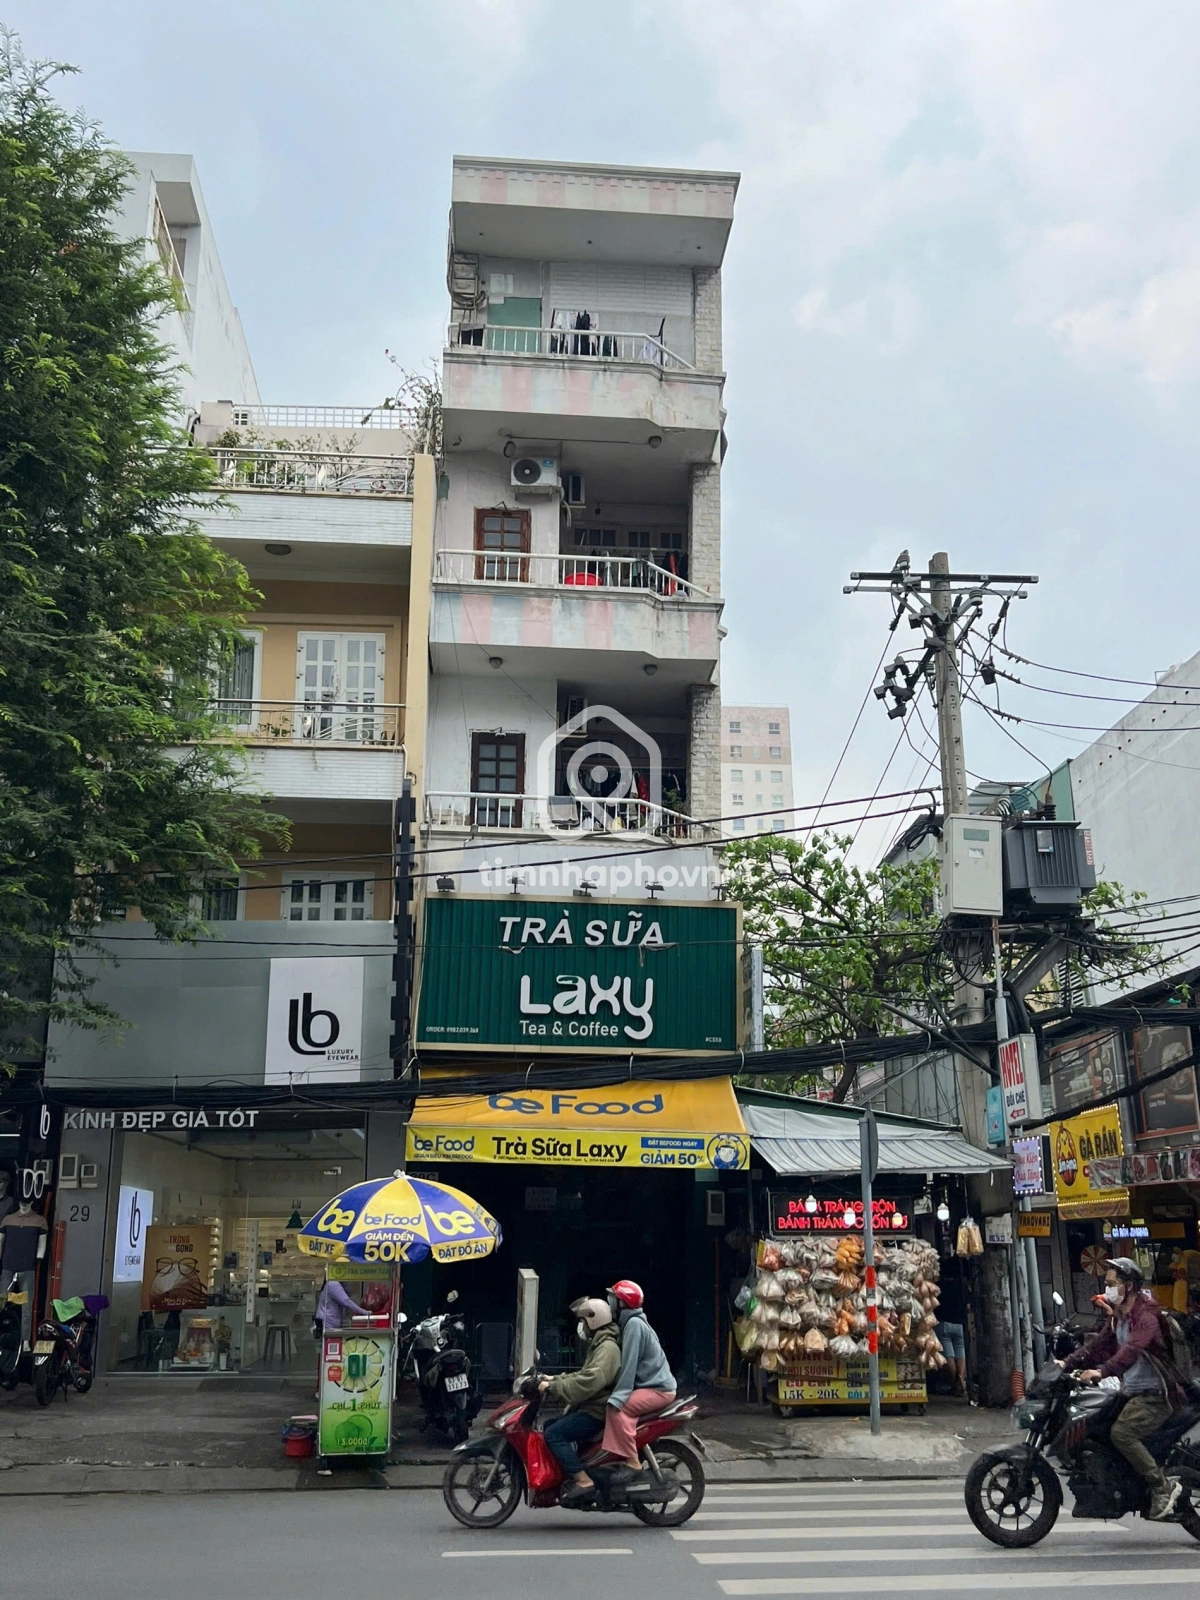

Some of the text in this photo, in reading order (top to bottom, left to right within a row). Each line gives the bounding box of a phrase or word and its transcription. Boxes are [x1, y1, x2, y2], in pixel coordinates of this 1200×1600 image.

[500, 909, 664, 946] TRÀ SỮA
[520, 975, 654, 1040] Laxy
[520, 1020, 619, 1036] Tea & Coffee
[1000, 1041, 1024, 1089] HOTEL
[552, 1094, 664, 1115] Food
[64, 1106, 259, 1132] KÍNH ĐẸP GIÁ TỐT
[492, 1136, 627, 1162] Trà Sữa Laxy
[1079, 1125, 1119, 1160] GÀ RÁN
[640, 1150, 704, 1165] GIẢM 50%
[70, 1205, 90, 1222] 29
[788, 1198, 822, 1212] BÁH
[870, 1198, 896, 1214] RỘN
[318, 1199, 355, 1234] be
[384, 1214, 421, 1225] Food
[424, 1204, 475, 1236] be
[778, 1214, 810, 1229] BÁNH
[854, 1213, 888, 1229] CỐN
[365, 1230, 414, 1241] GIẢM ĐẾN
[309, 1239, 335, 1254] ĐẶT XE
[364, 1242, 412, 1262] 50K
[438, 1240, 487, 1260] ĐẶT ĐỒ ĂN
[783, 1390, 804, 1400] 15K
[817, 1389, 840, 1399] 20K
[351, 1398, 356, 1412] 1
